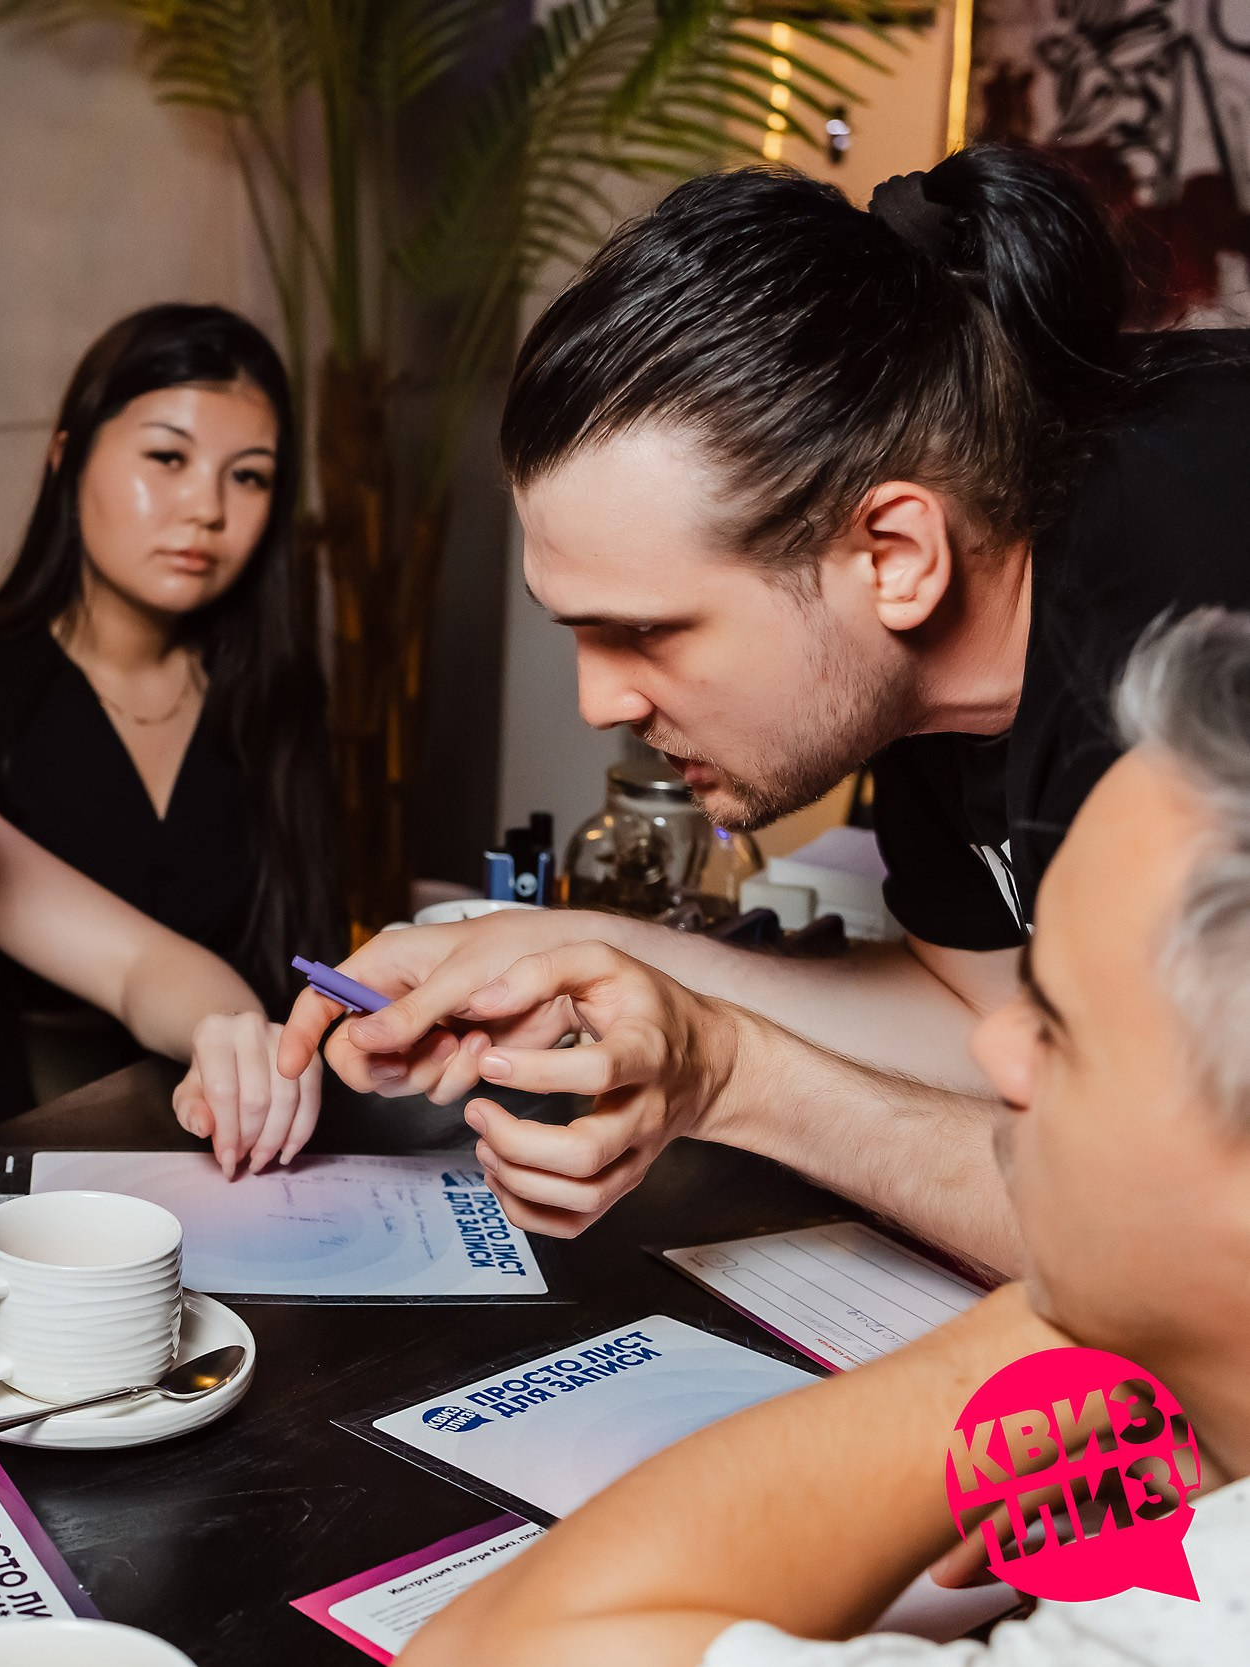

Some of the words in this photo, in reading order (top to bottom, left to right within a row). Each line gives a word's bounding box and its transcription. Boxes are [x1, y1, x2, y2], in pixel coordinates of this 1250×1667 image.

[442, 1191, 476, 1215] ДЛЯ
[472, 1192, 511, 1240] ПРОСТО
[456, 1218, 496, 1267] ЗАПИСИ
[490, 1243, 526, 1276] ЛИСТ
[465, 1359, 582, 1406] ПРОСТО
[578, 1331, 653, 1363] ЛИСТ
[489, 1387, 556, 1418] ДЛЯ
[548, 1347, 662, 1392] ЗАПИСИ
[388, 1567, 452, 1595] Инструкция
[453, 1561, 467, 1570] по
[467, 1552, 492, 1565] игре
[490, 1540, 521, 1553] Квиз,
[6, 1591, 53, 1620] ЛИ
